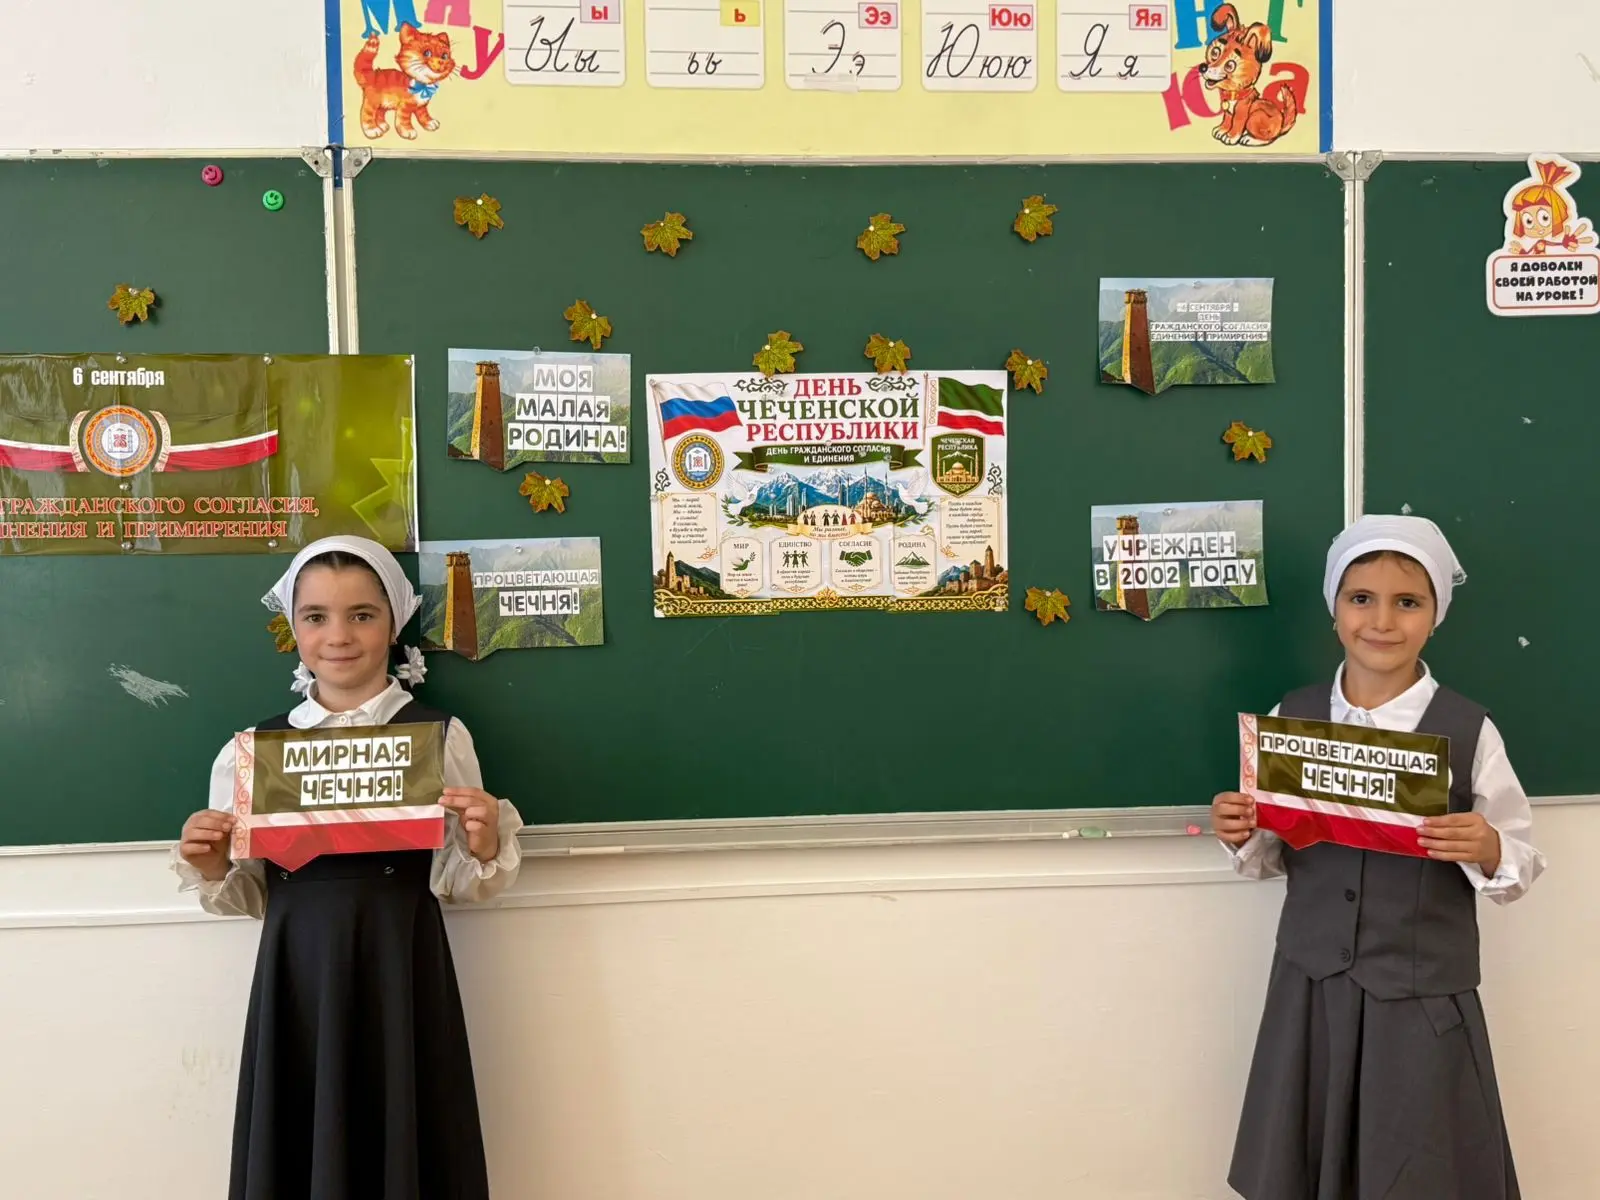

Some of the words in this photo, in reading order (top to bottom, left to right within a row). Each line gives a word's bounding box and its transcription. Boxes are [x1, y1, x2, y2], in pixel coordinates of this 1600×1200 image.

[864, 6, 892, 25] Ээ
[991, 8, 1031, 27] Юю
[1136, 9, 1162, 27] Яя
[1510, 262, 1518, 272] Я
[1520, 261, 1583, 272] ДОВОЛЕН
[1495, 276, 1535, 287] СВОЕЙ
[1537, 274, 1598, 286] РАБОТОЙ
[1516, 291, 1533, 301] НА
[1150, 323, 1221, 331] ГРАЖДАНСКОГО
[1199, 313, 1220, 321] ДЕНЬ
[73, 367, 83, 386] 6
[91, 367, 165, 388] сентября
[534, 366, 592, 389] МОЯ
[793, 378, 862, 399] ДЕНЬ
[515, 397, 611, 418] МАЛАЯ
[736, 392, 920, 420] ЧЕЧЕНСКОЙ
[508, 426, 626, 450] РОДИНА!
[746, 421, 919, 442] РЕСПУБЛИКИ
[766, 447, 788, 456] ДЕНЬ
[790, 445, 852, 455] ГРАЖДАНСКОГО
[853, 445, 891, 454] СОГЛАСИЯ
[812, 455, 855, 463] ЕДИНЕНИЯ
[0, 497, 186, 516] ГРАЖДАНСКОГО
[194, 497, 320, 517] СОГЛАСИЯ,
[0, 521, 88, 539] НЕНИЯ
[96, 521, 116, 538] И
[123, 520, 288, 538] ПРИМИРЕНИЯ
[1104, 535, 1236, 560] УЧРЕЖДЕН
[473, 571, 599, 586] ПРОЦВЕТАЮЩАЯ
[1096, 569, 1109, 586] В
[1120, 565, 1179, 585] 2002
[1190, 563, 1255, 584] ГОДУ
[500, 591, 579, 612] ЧЕЧНЯ!
[285, 741, 411, 769] МИРНАЯ
[1260, 734, 1438, 773] ПРОЦВЕТАЮЩАЯ
[302, 774, 403, 801] ЧЕЧНЯ!
[1303, 766, 1395, 799] ЧЕЧНЯ!
